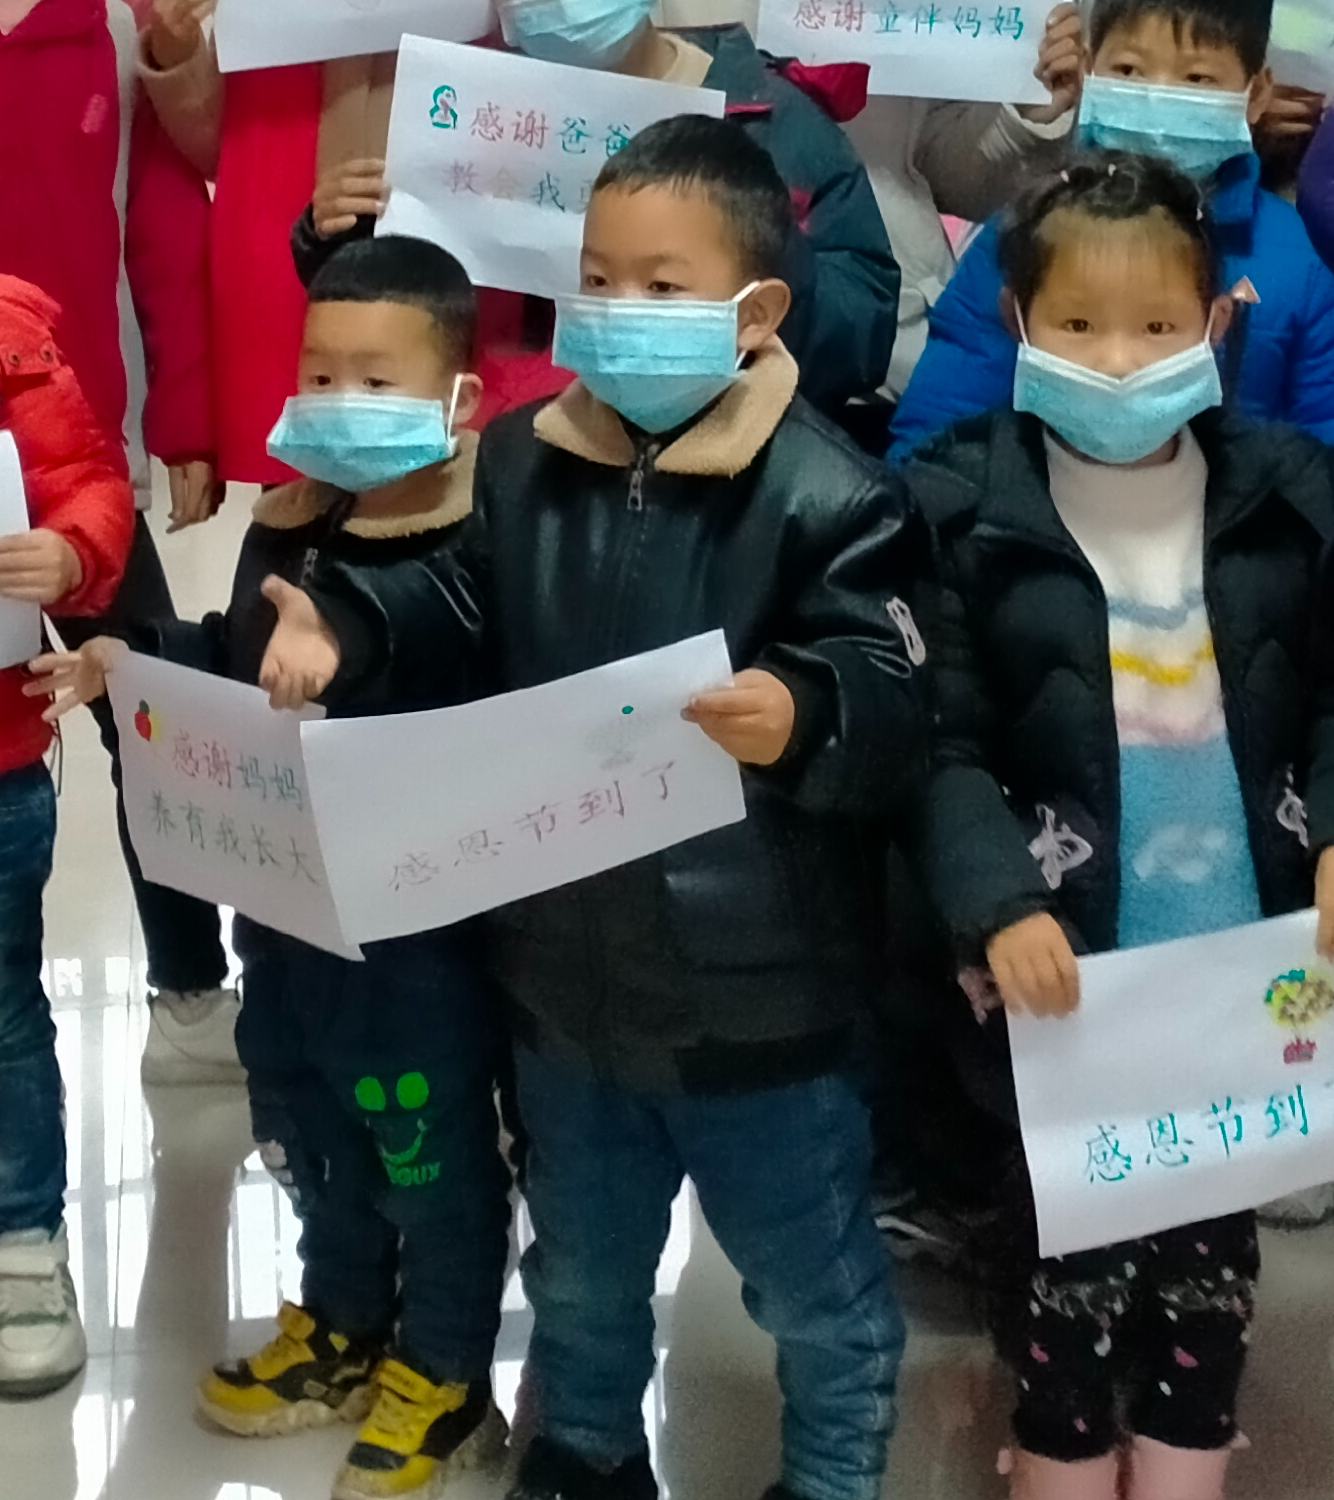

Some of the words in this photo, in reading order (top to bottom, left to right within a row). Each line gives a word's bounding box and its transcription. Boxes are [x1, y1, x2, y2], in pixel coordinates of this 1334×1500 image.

[172, 728, 304, 813] 感谢妈妈
[386, 760, 676, 893] 感恩节到了
